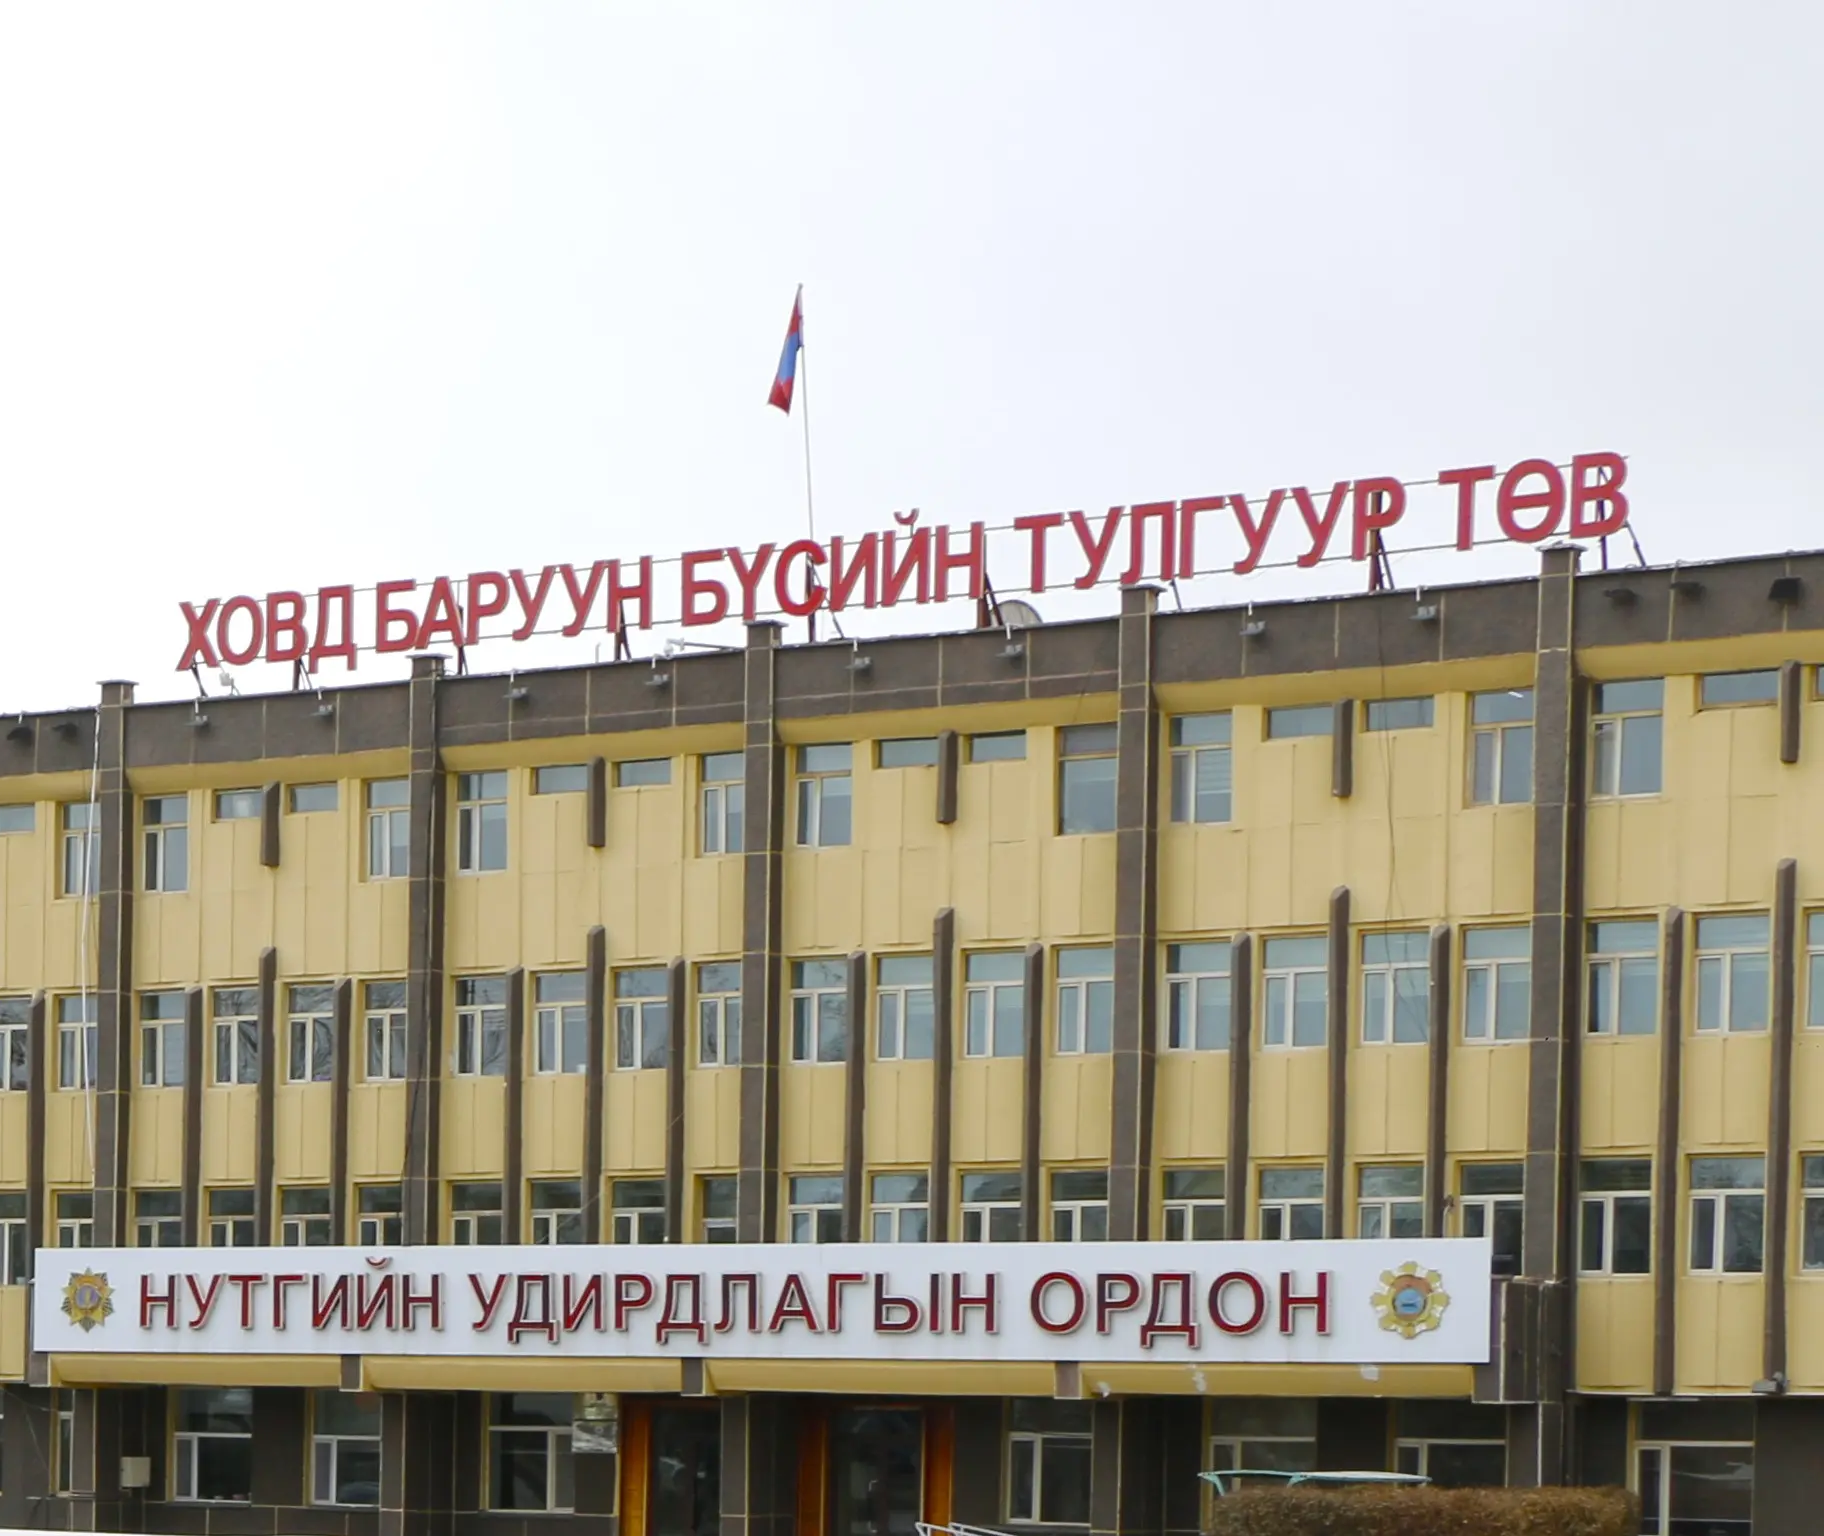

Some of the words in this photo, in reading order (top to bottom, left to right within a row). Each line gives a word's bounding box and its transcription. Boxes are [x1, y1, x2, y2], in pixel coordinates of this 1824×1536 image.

[175, 584, 358, 674] ХОВД
[376, 555, 652, 654] БАРУУН
[680, 508, 985, 628] БҮСИЙН
[1013, 476, 1407, 593] ТУЛГУУР
[1438, 451, 1629, 552] ТӨВ
[138, 1256, 445, 1332] НУТГИЙН
[468, 1271, 999, 1345] УДИРДЛАГЫН
[1029, 1270, 1332, 1349] ОРДОН
